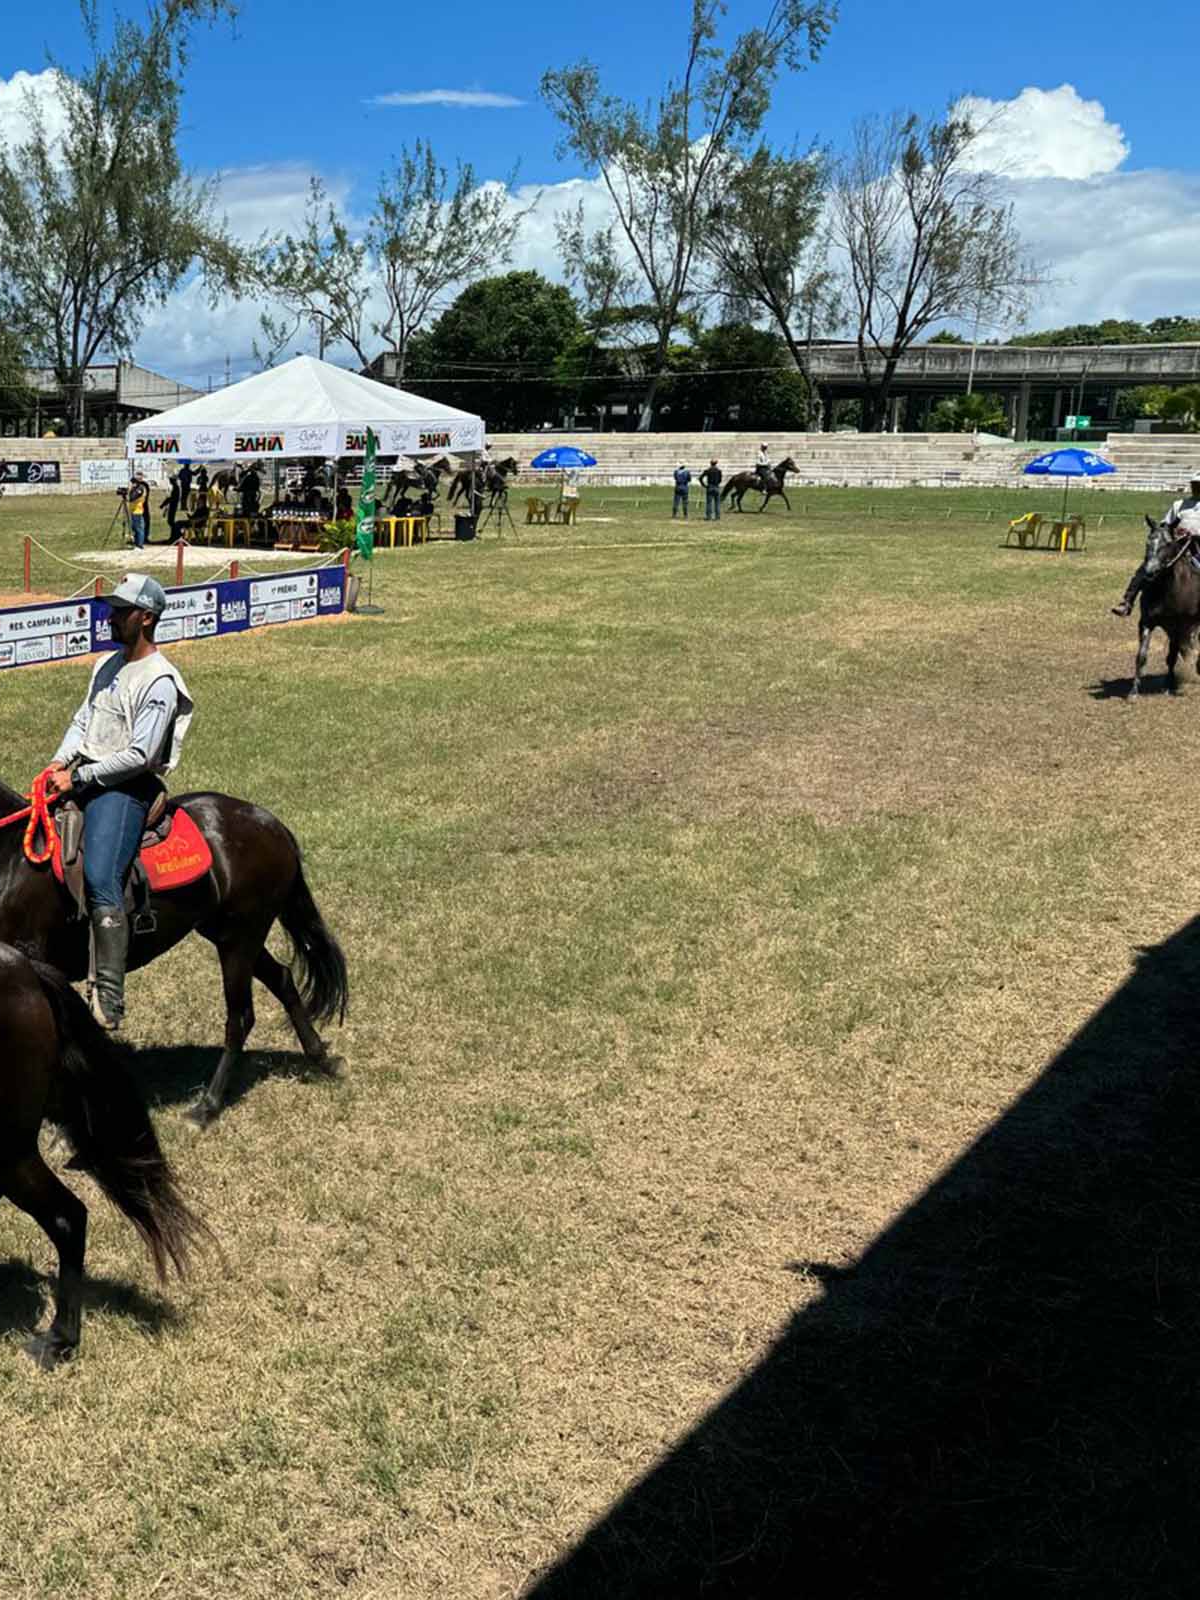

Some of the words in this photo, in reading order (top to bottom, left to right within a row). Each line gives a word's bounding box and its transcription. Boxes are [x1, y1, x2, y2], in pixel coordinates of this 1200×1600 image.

[135, 439, 180, 453] BAHIA
[234, 437, 284, 452] BAHIA
[345, 434, 381, 450] BAHA
[419, 433, 451, 448] BAHIA
[221, 599, 247, 616] BAHIA
[8, 621, 25, 631] RES.
[27, 615, 61, 629] CAMPEÃO
[68, 643, 89, 653] VETNIL
